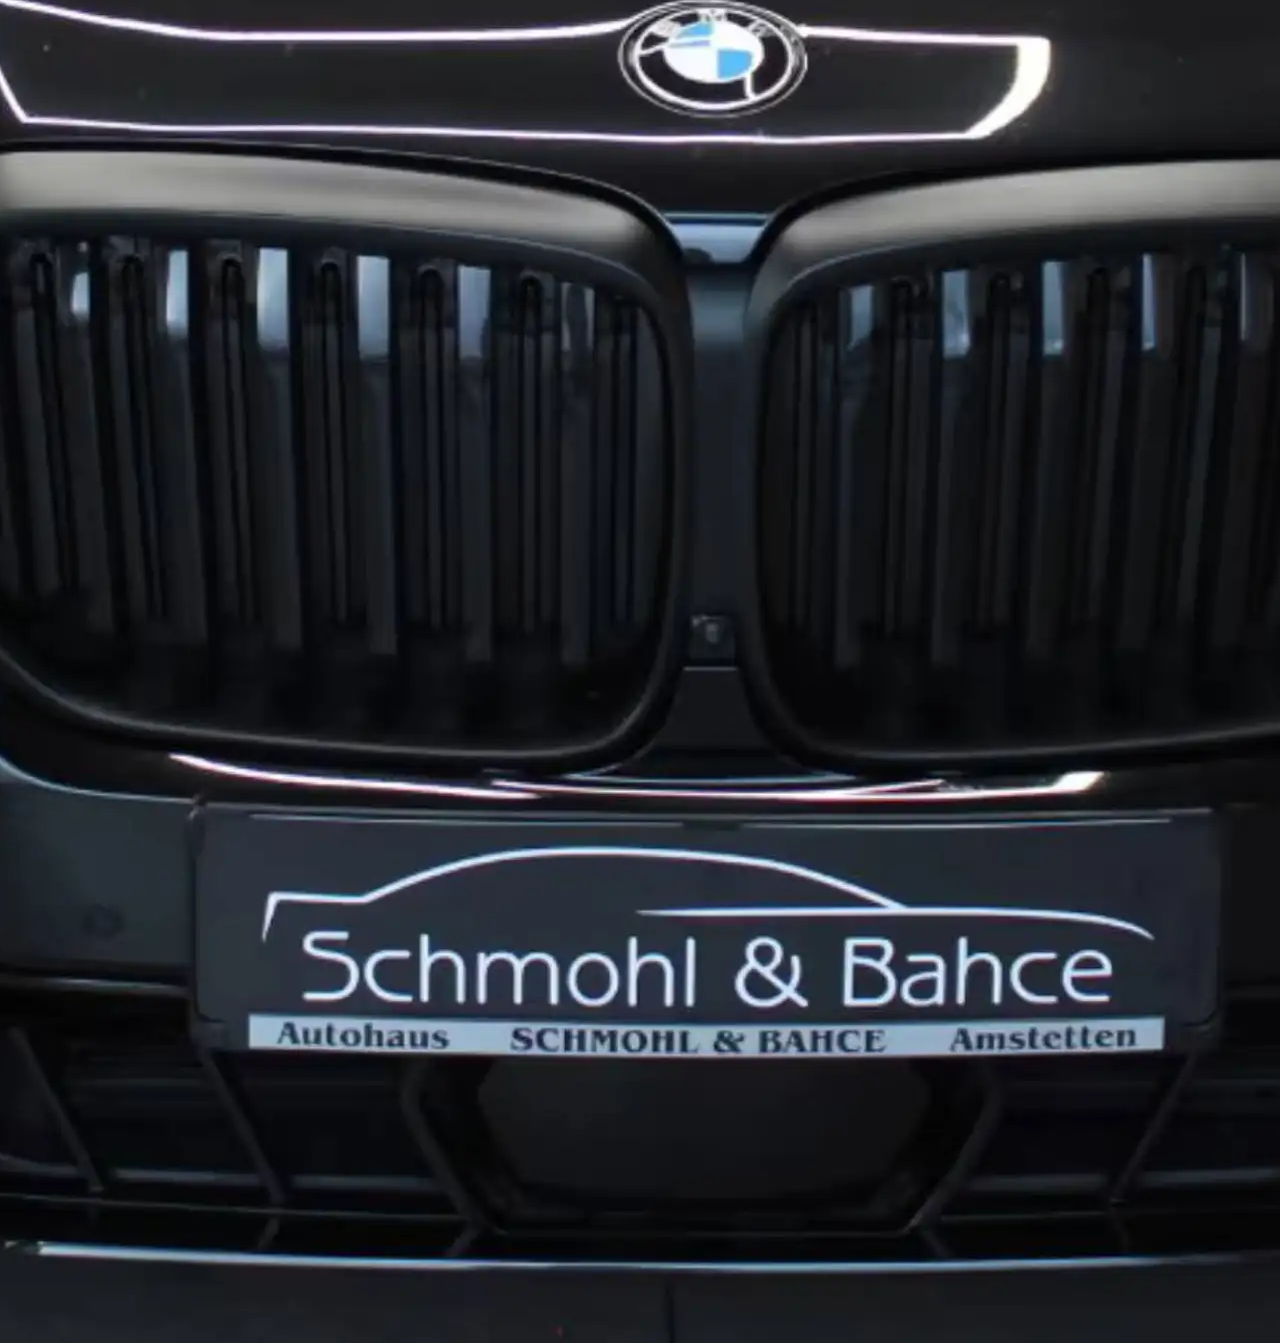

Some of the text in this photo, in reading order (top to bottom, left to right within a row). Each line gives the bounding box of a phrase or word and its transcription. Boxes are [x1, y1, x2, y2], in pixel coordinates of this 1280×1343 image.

[302, 931, 1113, 1008] Schmohl & Bahce
[277, 1021, 1137, 1055] Autohaus SCHMOHL & BAHCE Amstetten
